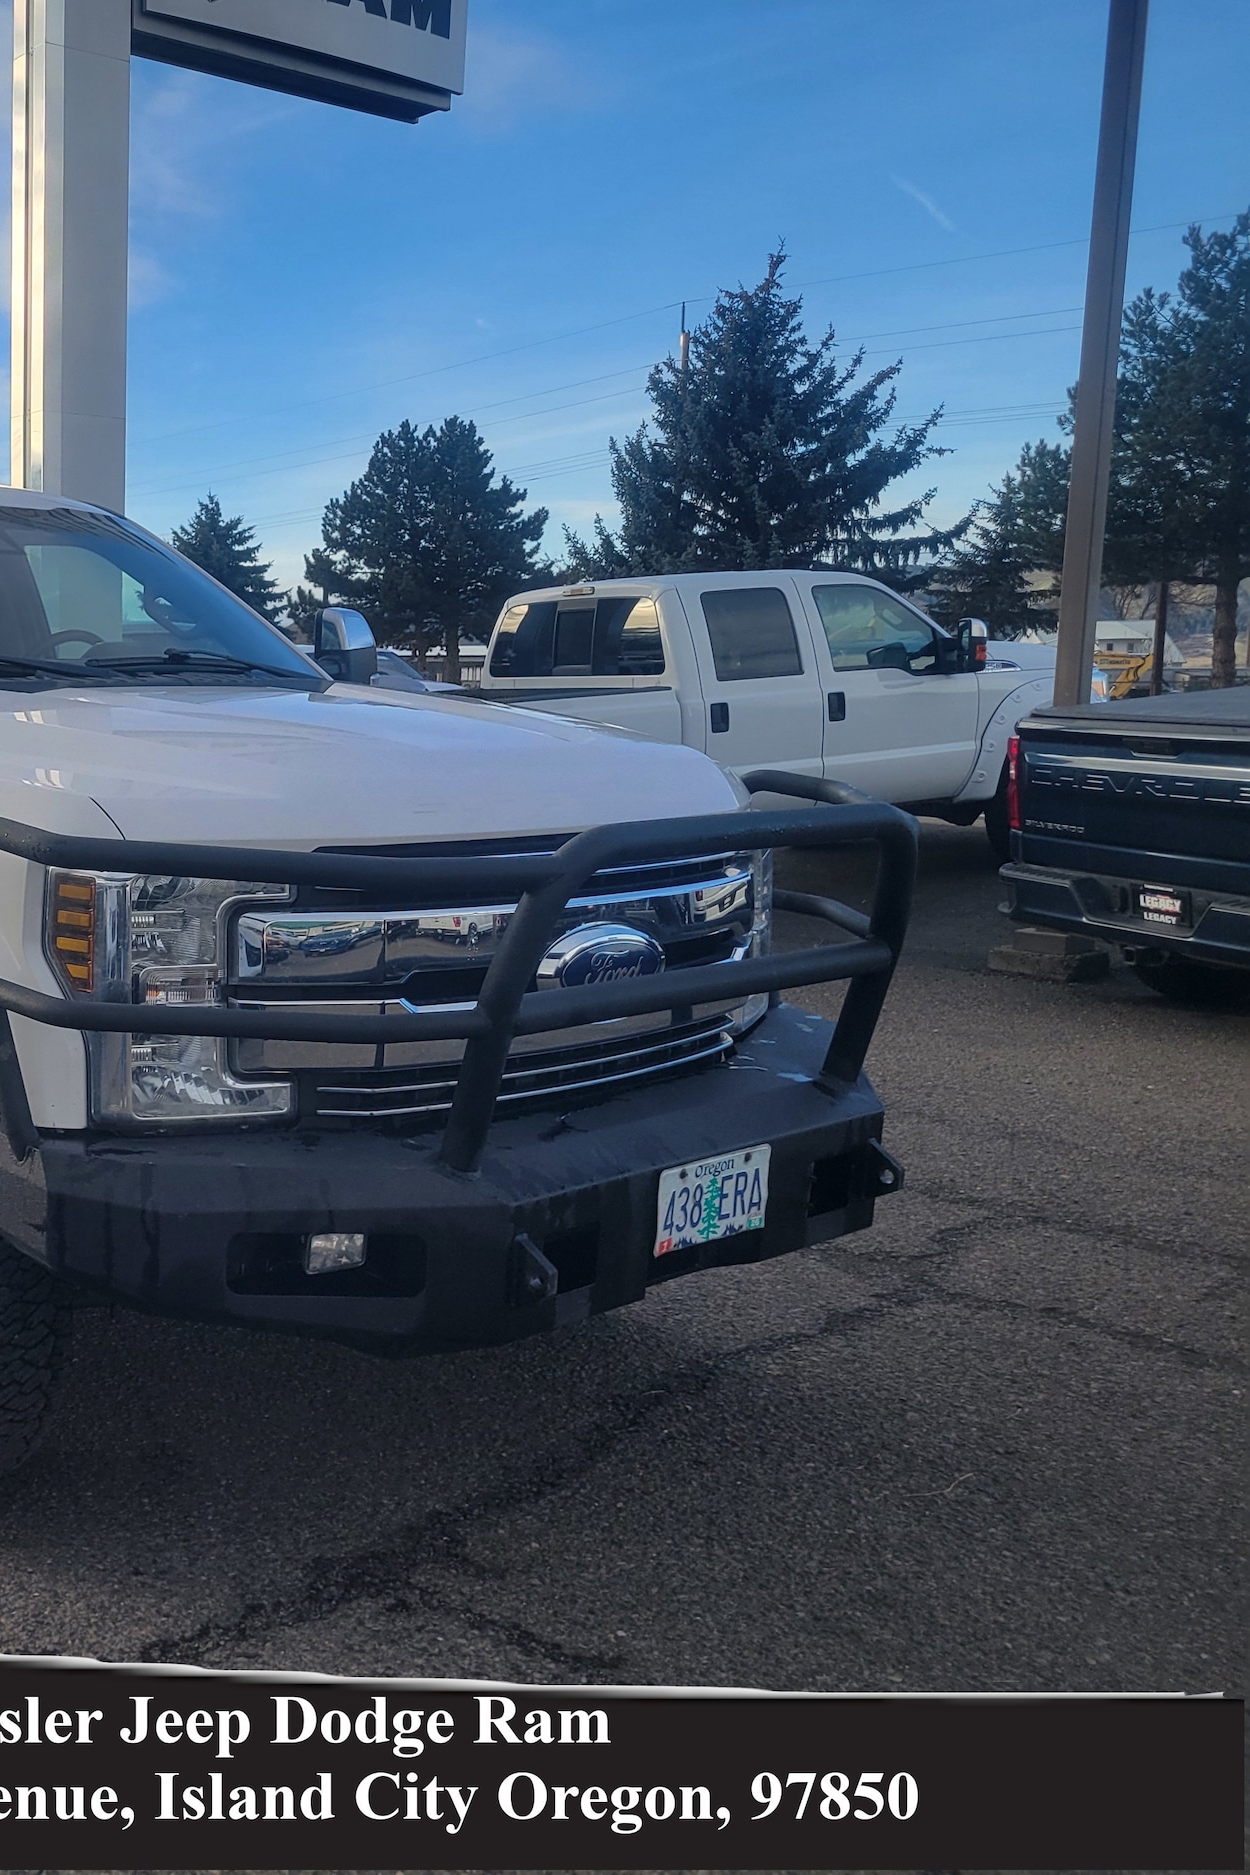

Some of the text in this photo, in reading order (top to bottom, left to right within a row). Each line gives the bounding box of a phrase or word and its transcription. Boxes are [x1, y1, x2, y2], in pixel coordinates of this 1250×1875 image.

[1139, 893, 1182, 913] LEGACY
[1143, 911, 1177, 925] LEGACY
[694, 1158, 735, 1179] Oregon
[662, 1167, 763, 1236] 438 ERA
